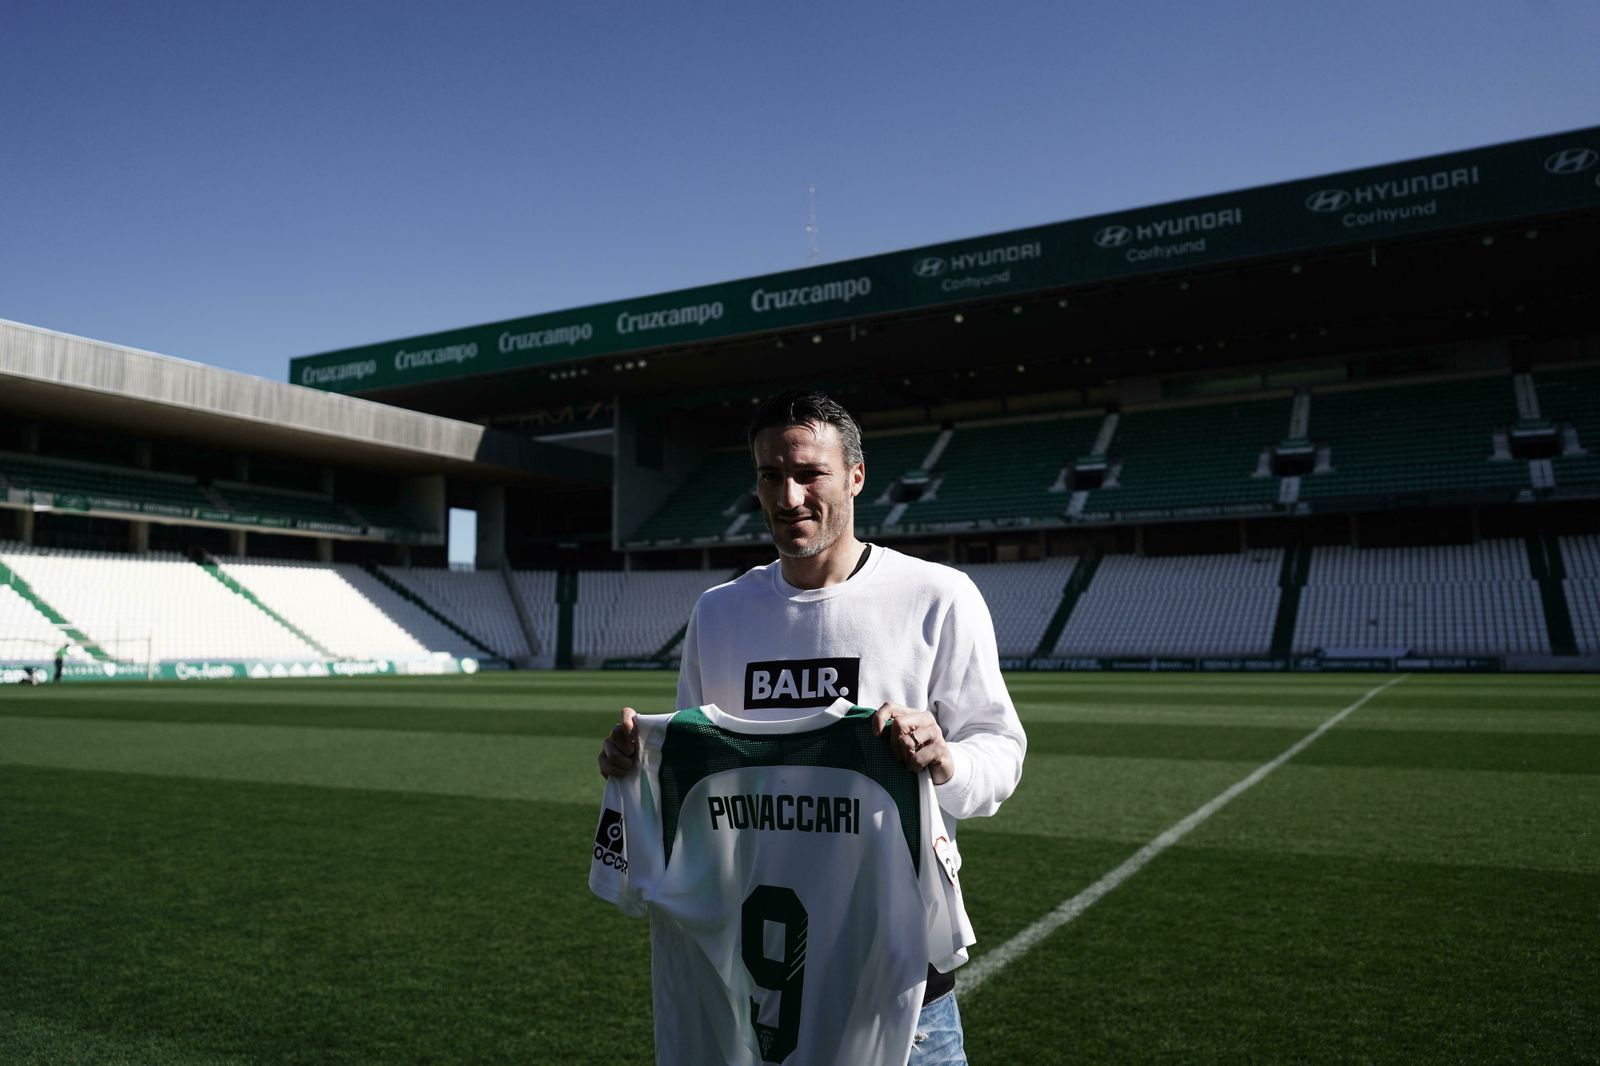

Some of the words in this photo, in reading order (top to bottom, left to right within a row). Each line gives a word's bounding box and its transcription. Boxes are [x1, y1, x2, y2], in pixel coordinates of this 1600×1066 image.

[1354, 166, 1480, 203] HYUNDAI
[1135, 207, 1243, 241] HYUNDAI
[1342, 199, 1438, 228] Corhyund
[949, 241, 1042, 271] HYUNDAI
[750, 274, 873, 315] Cruzcampo
[615, 300, 725, 337] Cruzcampo
[497, 321, 593, 355] Cruzcampo
[301, 358, 377, 386] Cruzcampo
[393, 341, 479, 371] Cruzcampo
[751, 667, 851, 701] BALR.
[708, 794, 861, 835] PIOVACCARI
[741, 885, 809, 1063] 9
